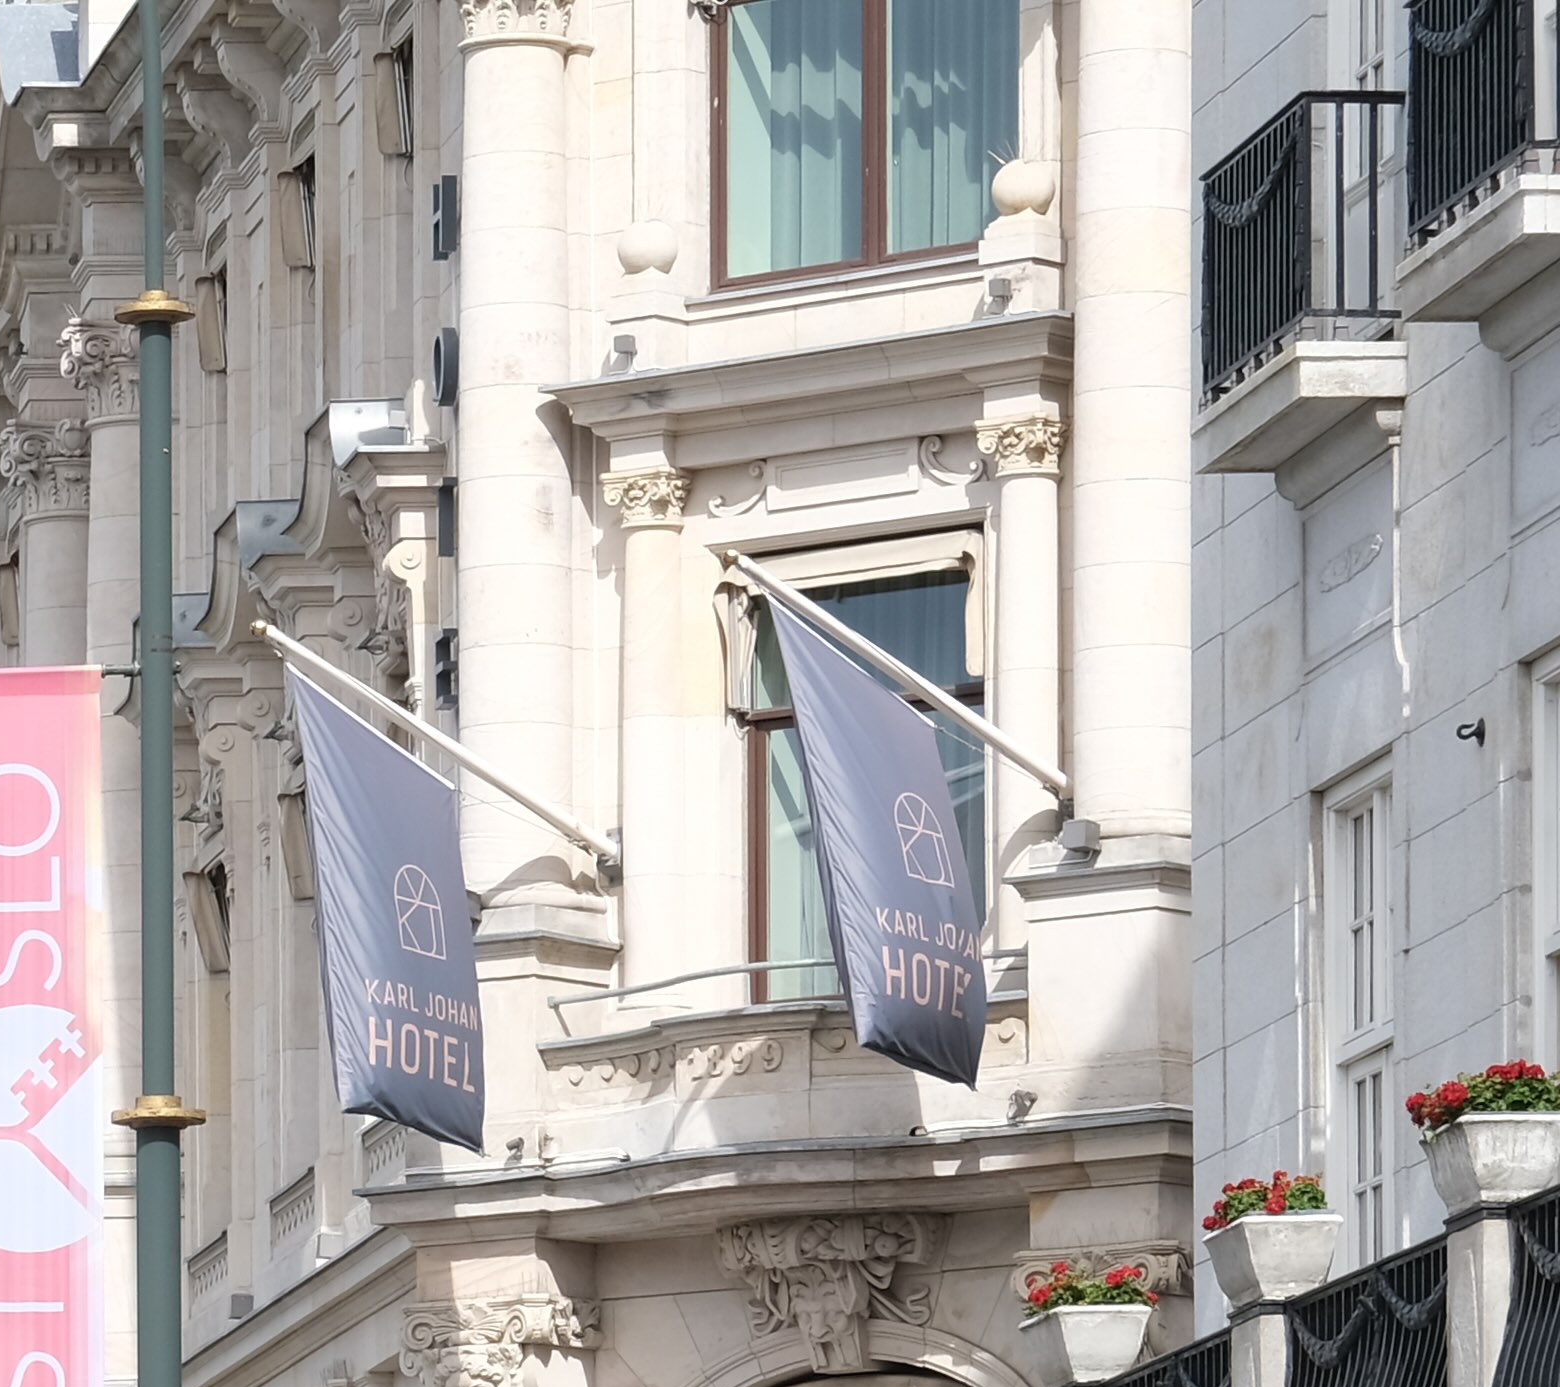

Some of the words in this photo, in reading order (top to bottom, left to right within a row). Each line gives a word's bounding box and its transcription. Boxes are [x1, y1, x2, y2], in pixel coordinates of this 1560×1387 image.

[876, 906, 930, 942] KARL
[365, 978, 420, 1013] KARL
[425, 992, 479, 1031] JOHAN
[369, 1016, 476, 1093] HOTEL
